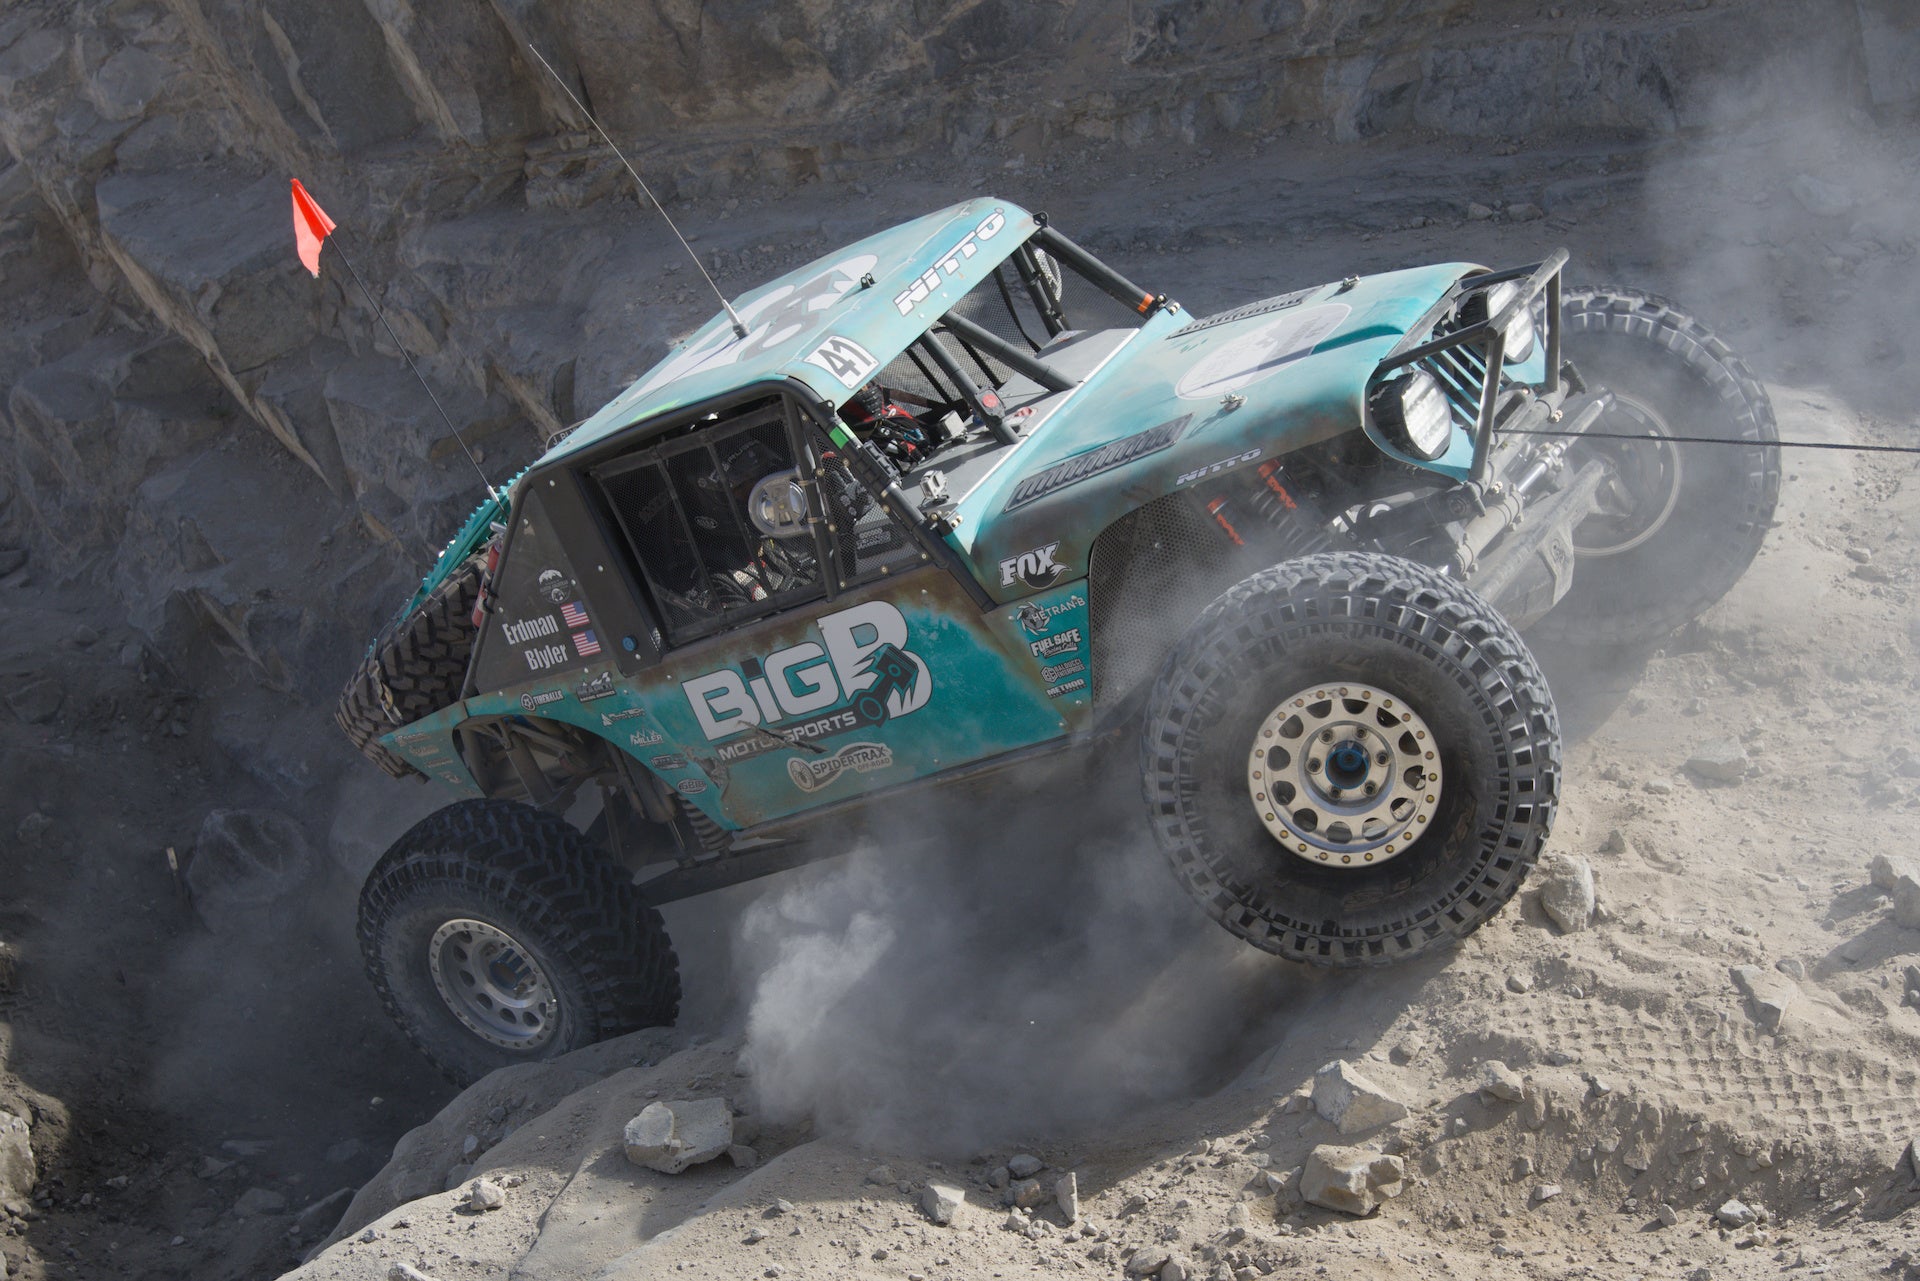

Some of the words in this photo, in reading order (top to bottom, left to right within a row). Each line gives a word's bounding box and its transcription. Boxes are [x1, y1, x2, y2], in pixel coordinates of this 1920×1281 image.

[893, 208, 1006, 317] NITTO
[822, 338, 869, 380] 41
[1175, 448, 1263, 486] NITTO
[999, 541, 1060, 587] FOX
[502, 614, 560, 646] Erdman
[1031, 637, 1055, 657] FUEL
[1053, 629, 1082, 645] SAFE
[524, 644, 569, 671] Blyler
[1047, 678, 1085, 695] METHOD
[718, 711, 857, 762] MOTOSPORTS
[812, 745, 888, 775] SPIDERTRAX
